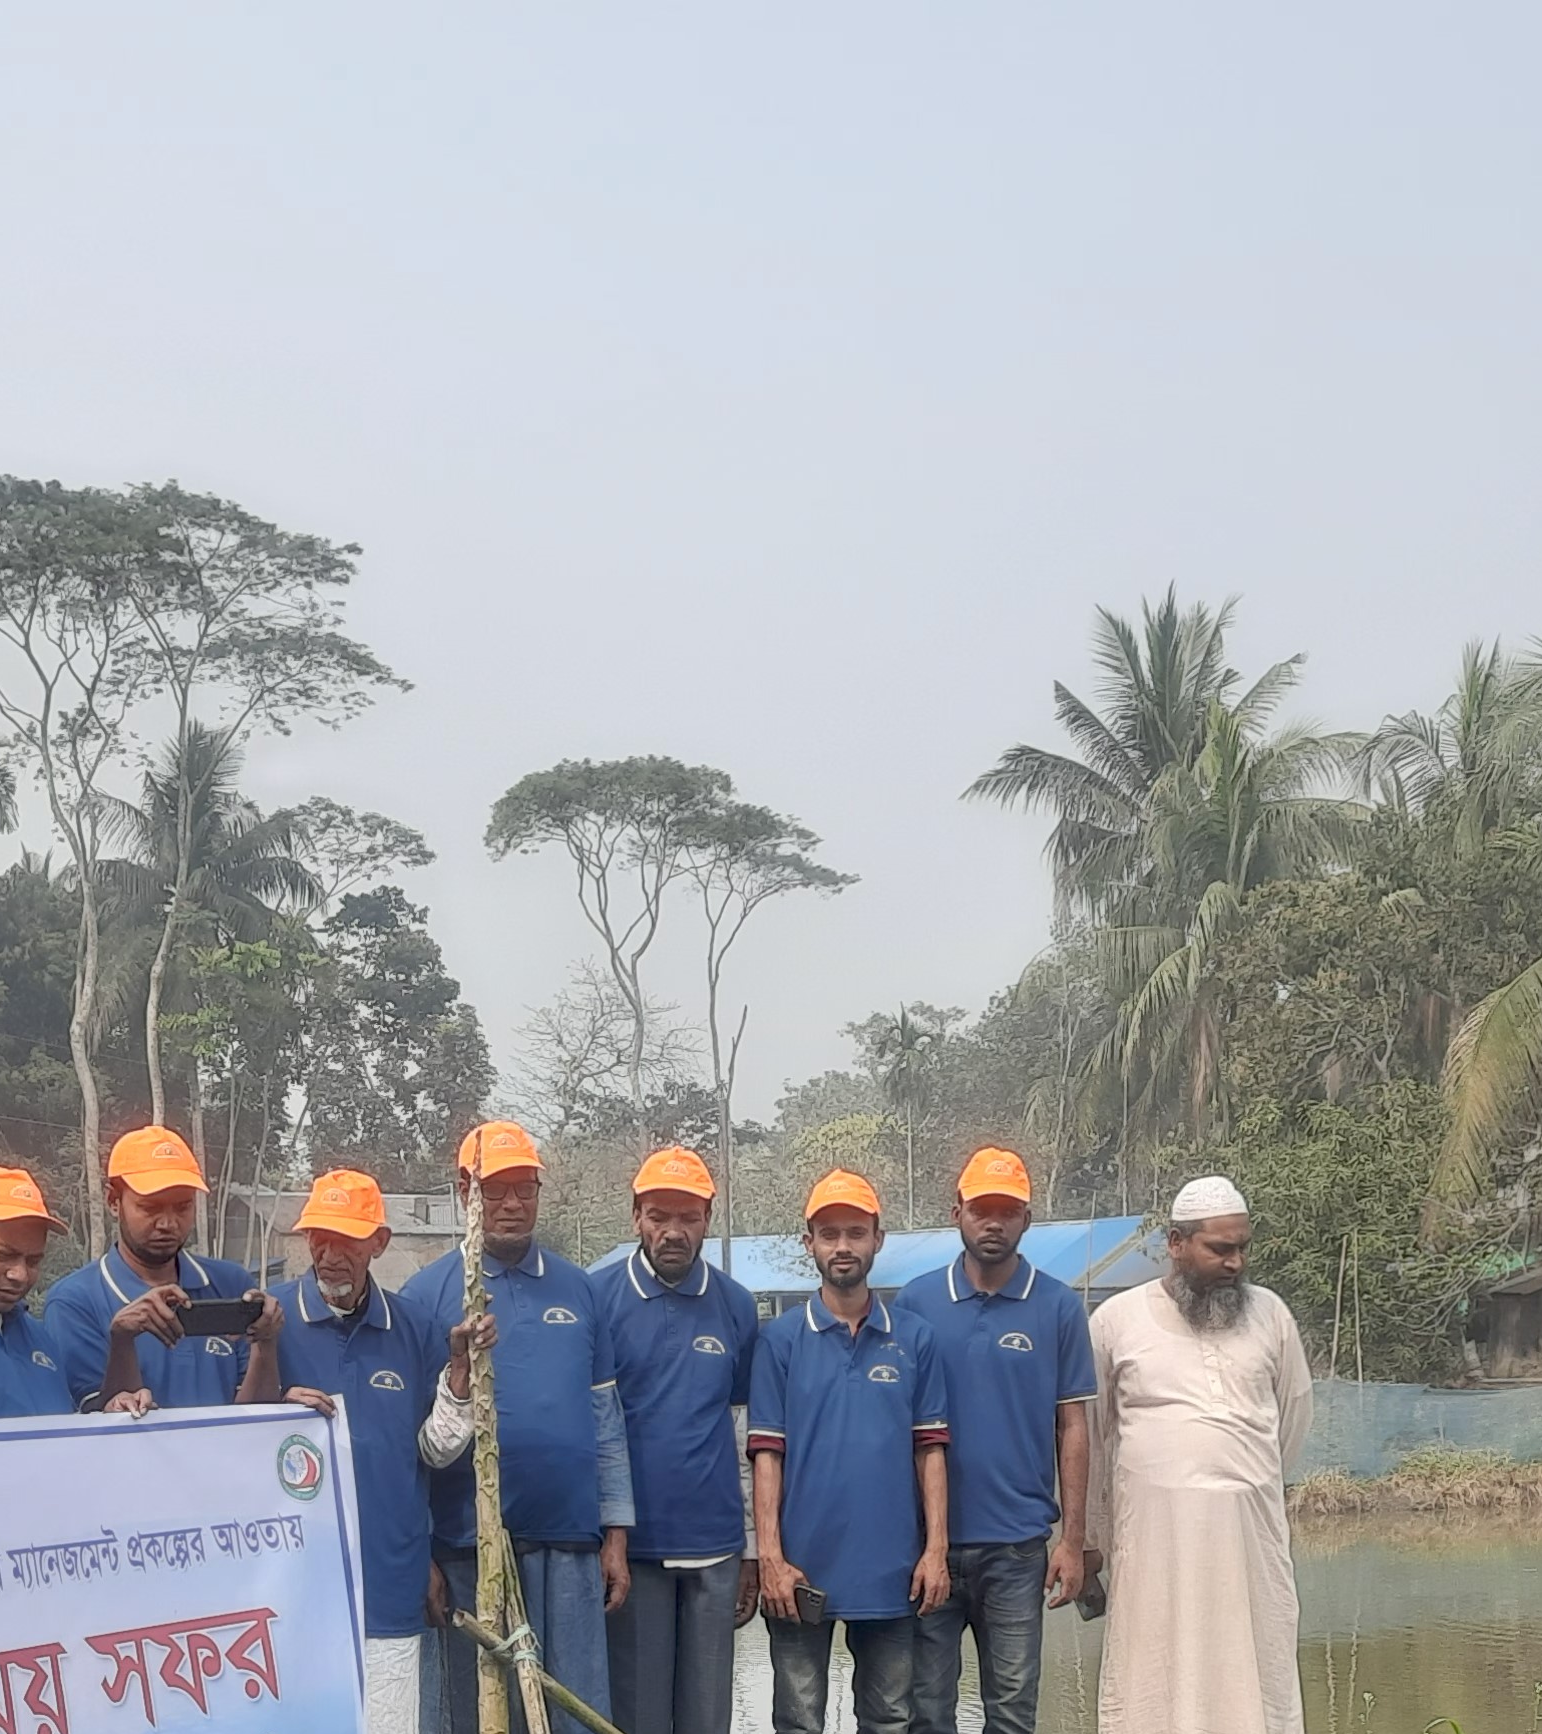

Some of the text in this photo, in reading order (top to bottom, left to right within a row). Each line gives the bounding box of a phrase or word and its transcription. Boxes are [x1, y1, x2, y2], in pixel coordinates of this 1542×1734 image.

[5, 1523, 120, 1590] ম্যানেজমেন্ট
[126, 1526, 206, 1574] প্রকল্পের
[210, 1511, 306, 1560] আওতায়
[84, 1607, 280, 1728] সফর
